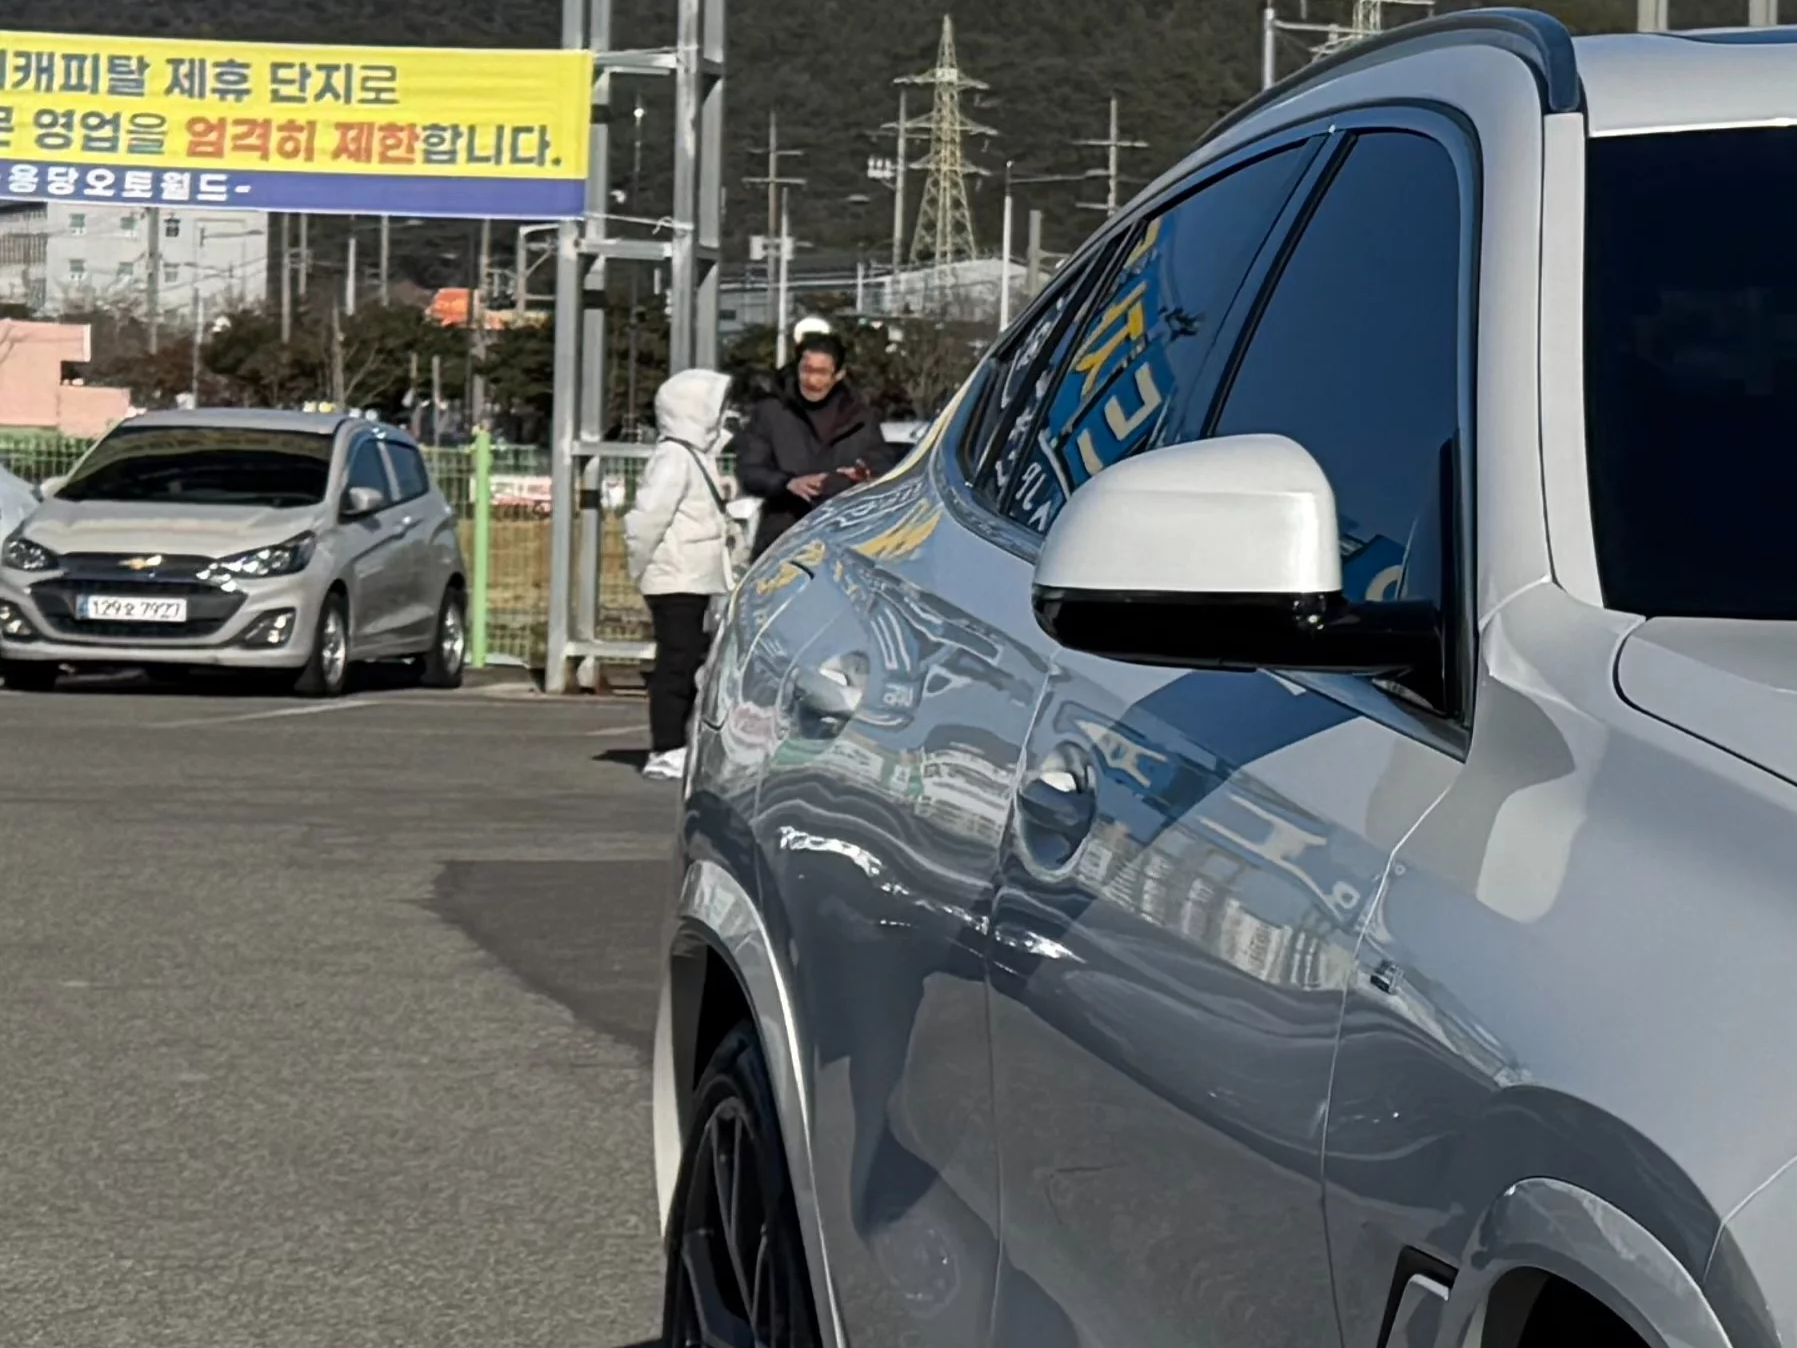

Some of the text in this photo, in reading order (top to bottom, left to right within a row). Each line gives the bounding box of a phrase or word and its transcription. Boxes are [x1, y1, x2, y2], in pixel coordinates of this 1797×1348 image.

[0, 49, 399, 105] 캐피탈 제휴 단지로
[33, 108, 168, 155] 영업을
[185, 116, 317, 162] 엄격히
